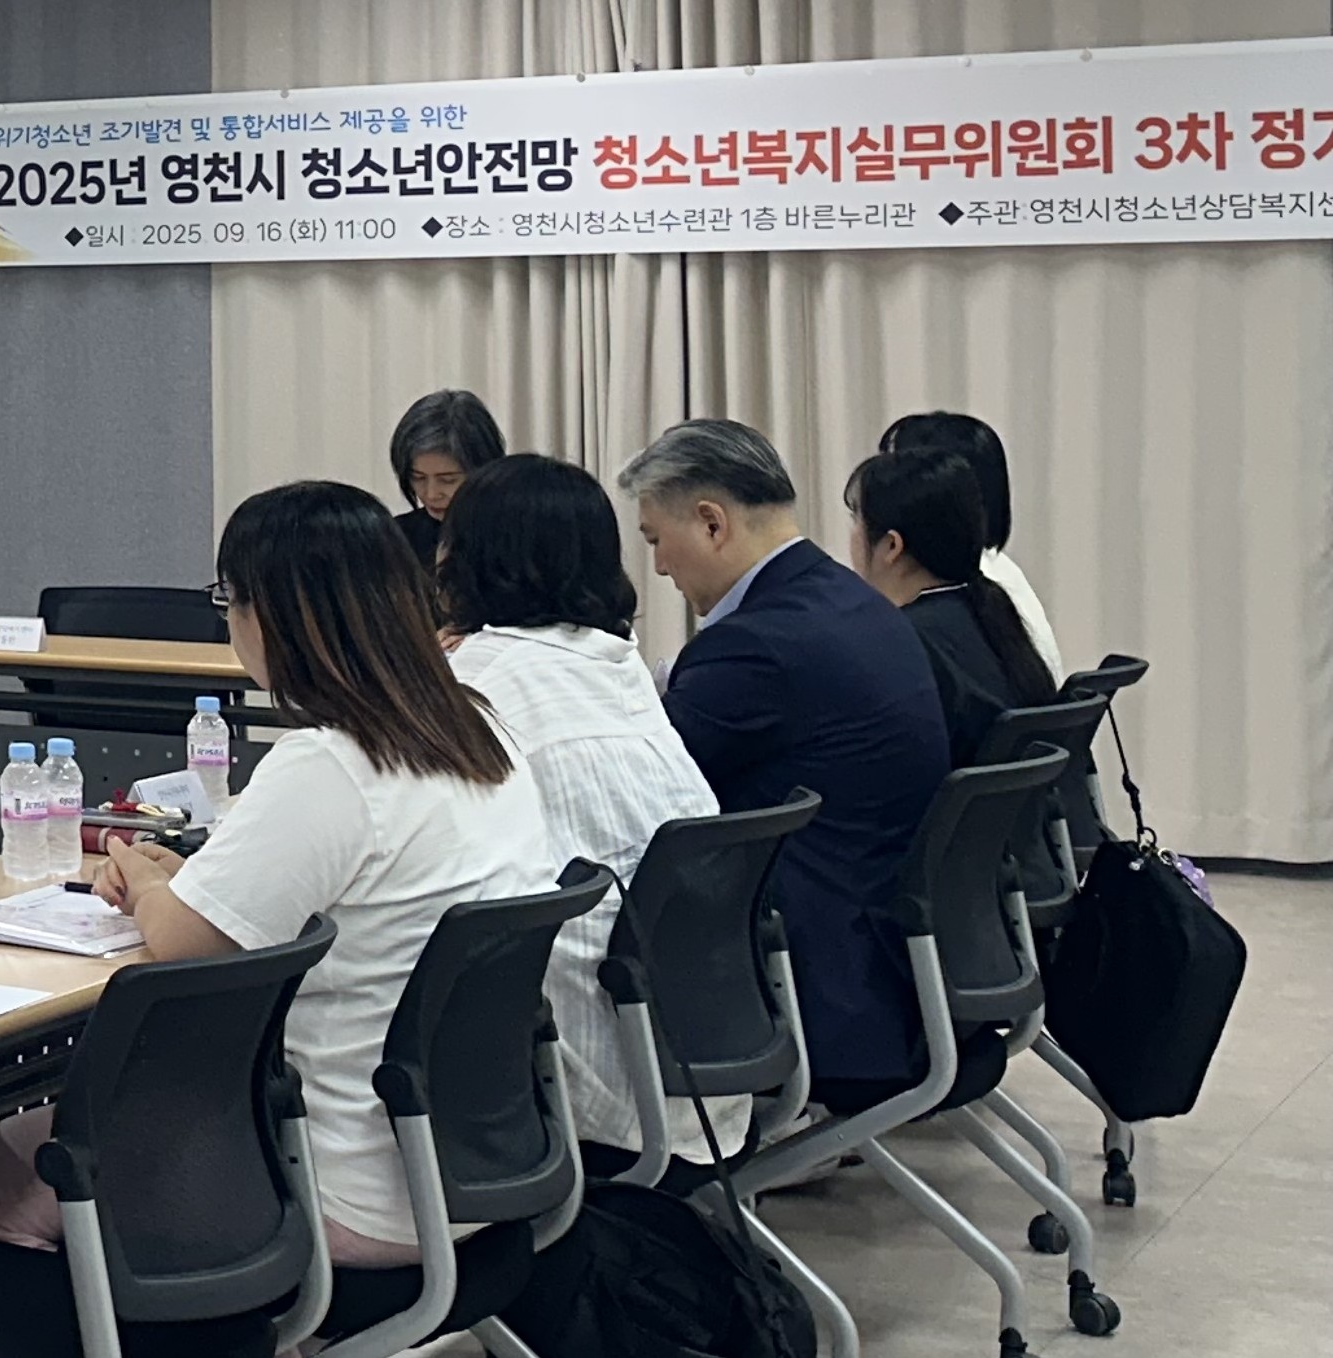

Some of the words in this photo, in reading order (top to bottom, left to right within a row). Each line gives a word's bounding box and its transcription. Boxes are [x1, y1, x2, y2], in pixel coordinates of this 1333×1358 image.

[99, 119, 182, 144] 조기발견
[191, 117, 211, 142] 및
[219, 111, 331, 141] 통합서비스
[339, 107, 411, 134] 제공을
[420, 104, 468, 130] 위한
[161, 150, 285, 204] 영천시
[301, 137, 578, 200] 청소년안전망
[593, 115, 1113, 190] 청소년복지실무위원회
[1134, 111, 1234, 171] 3차
[335, 217, 396, 240] 11:00
[512, 206, 732, 237] 영천시청소년수련관
[740, 206, 777, 231] 1층
[785, 202, 916, 230] 바른누리관
